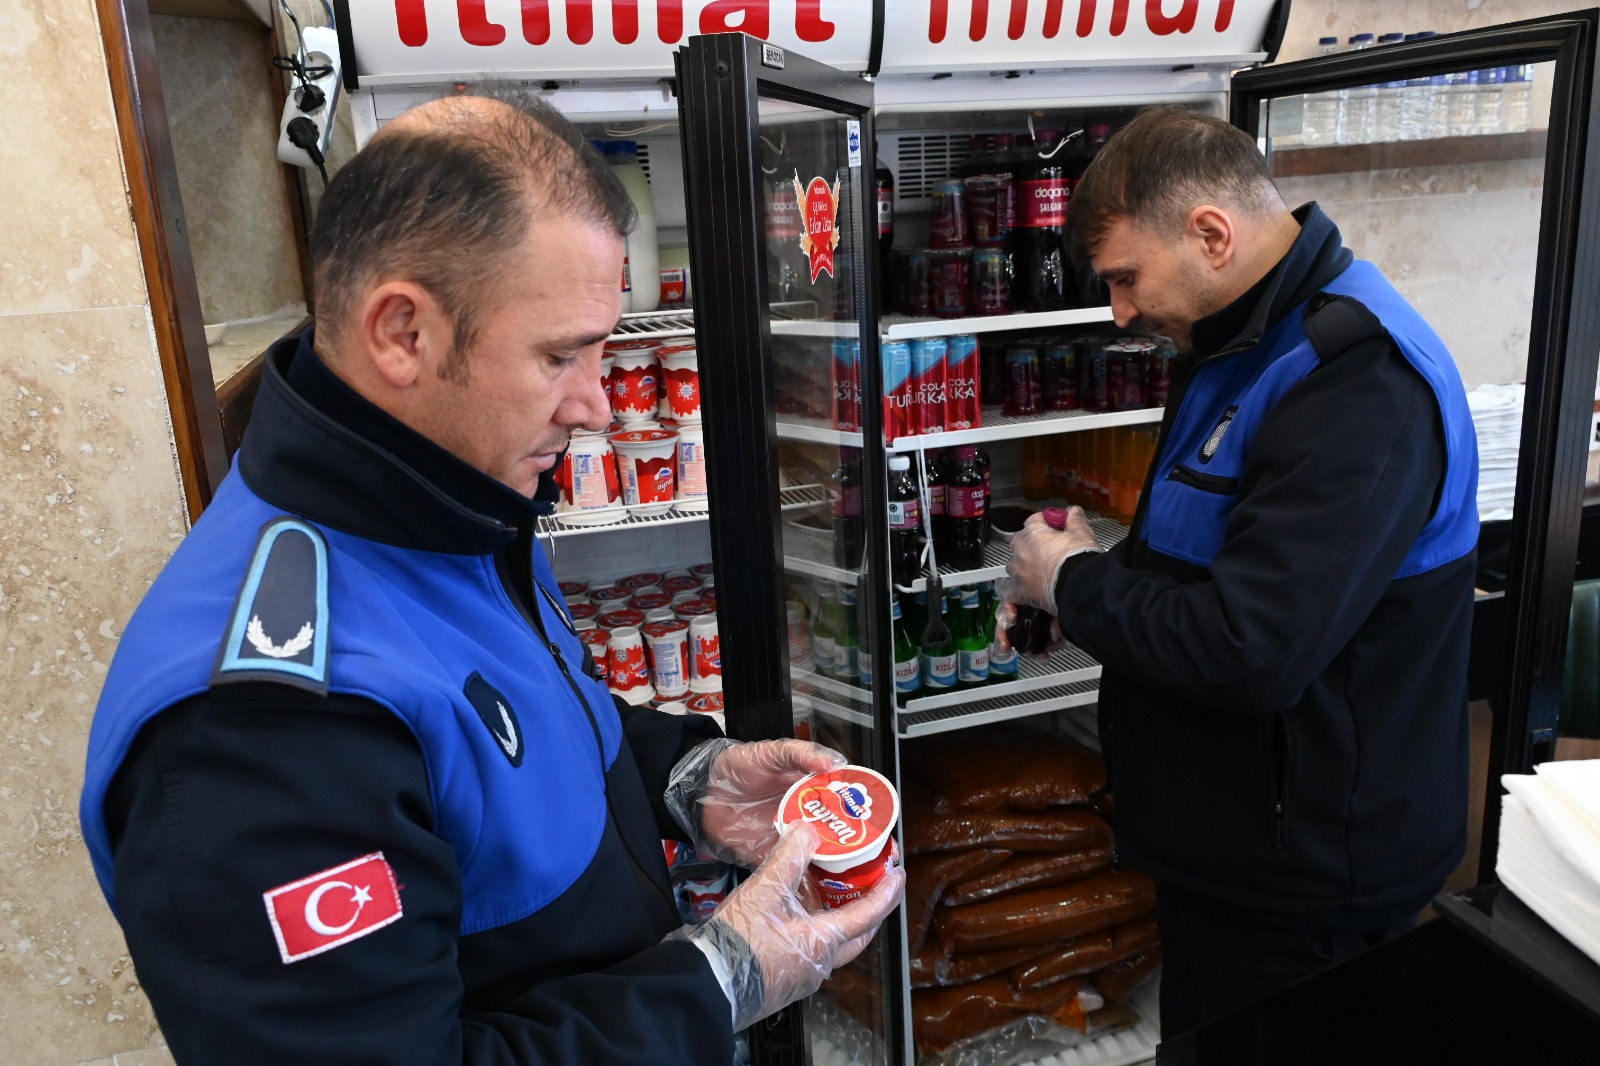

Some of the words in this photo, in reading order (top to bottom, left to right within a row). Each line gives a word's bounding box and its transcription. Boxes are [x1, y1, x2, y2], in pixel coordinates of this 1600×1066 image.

[919, 382, 947, 393] COLA
[803, 799, 856, 845] ayran
[826, 891, 861, 905] ayran
